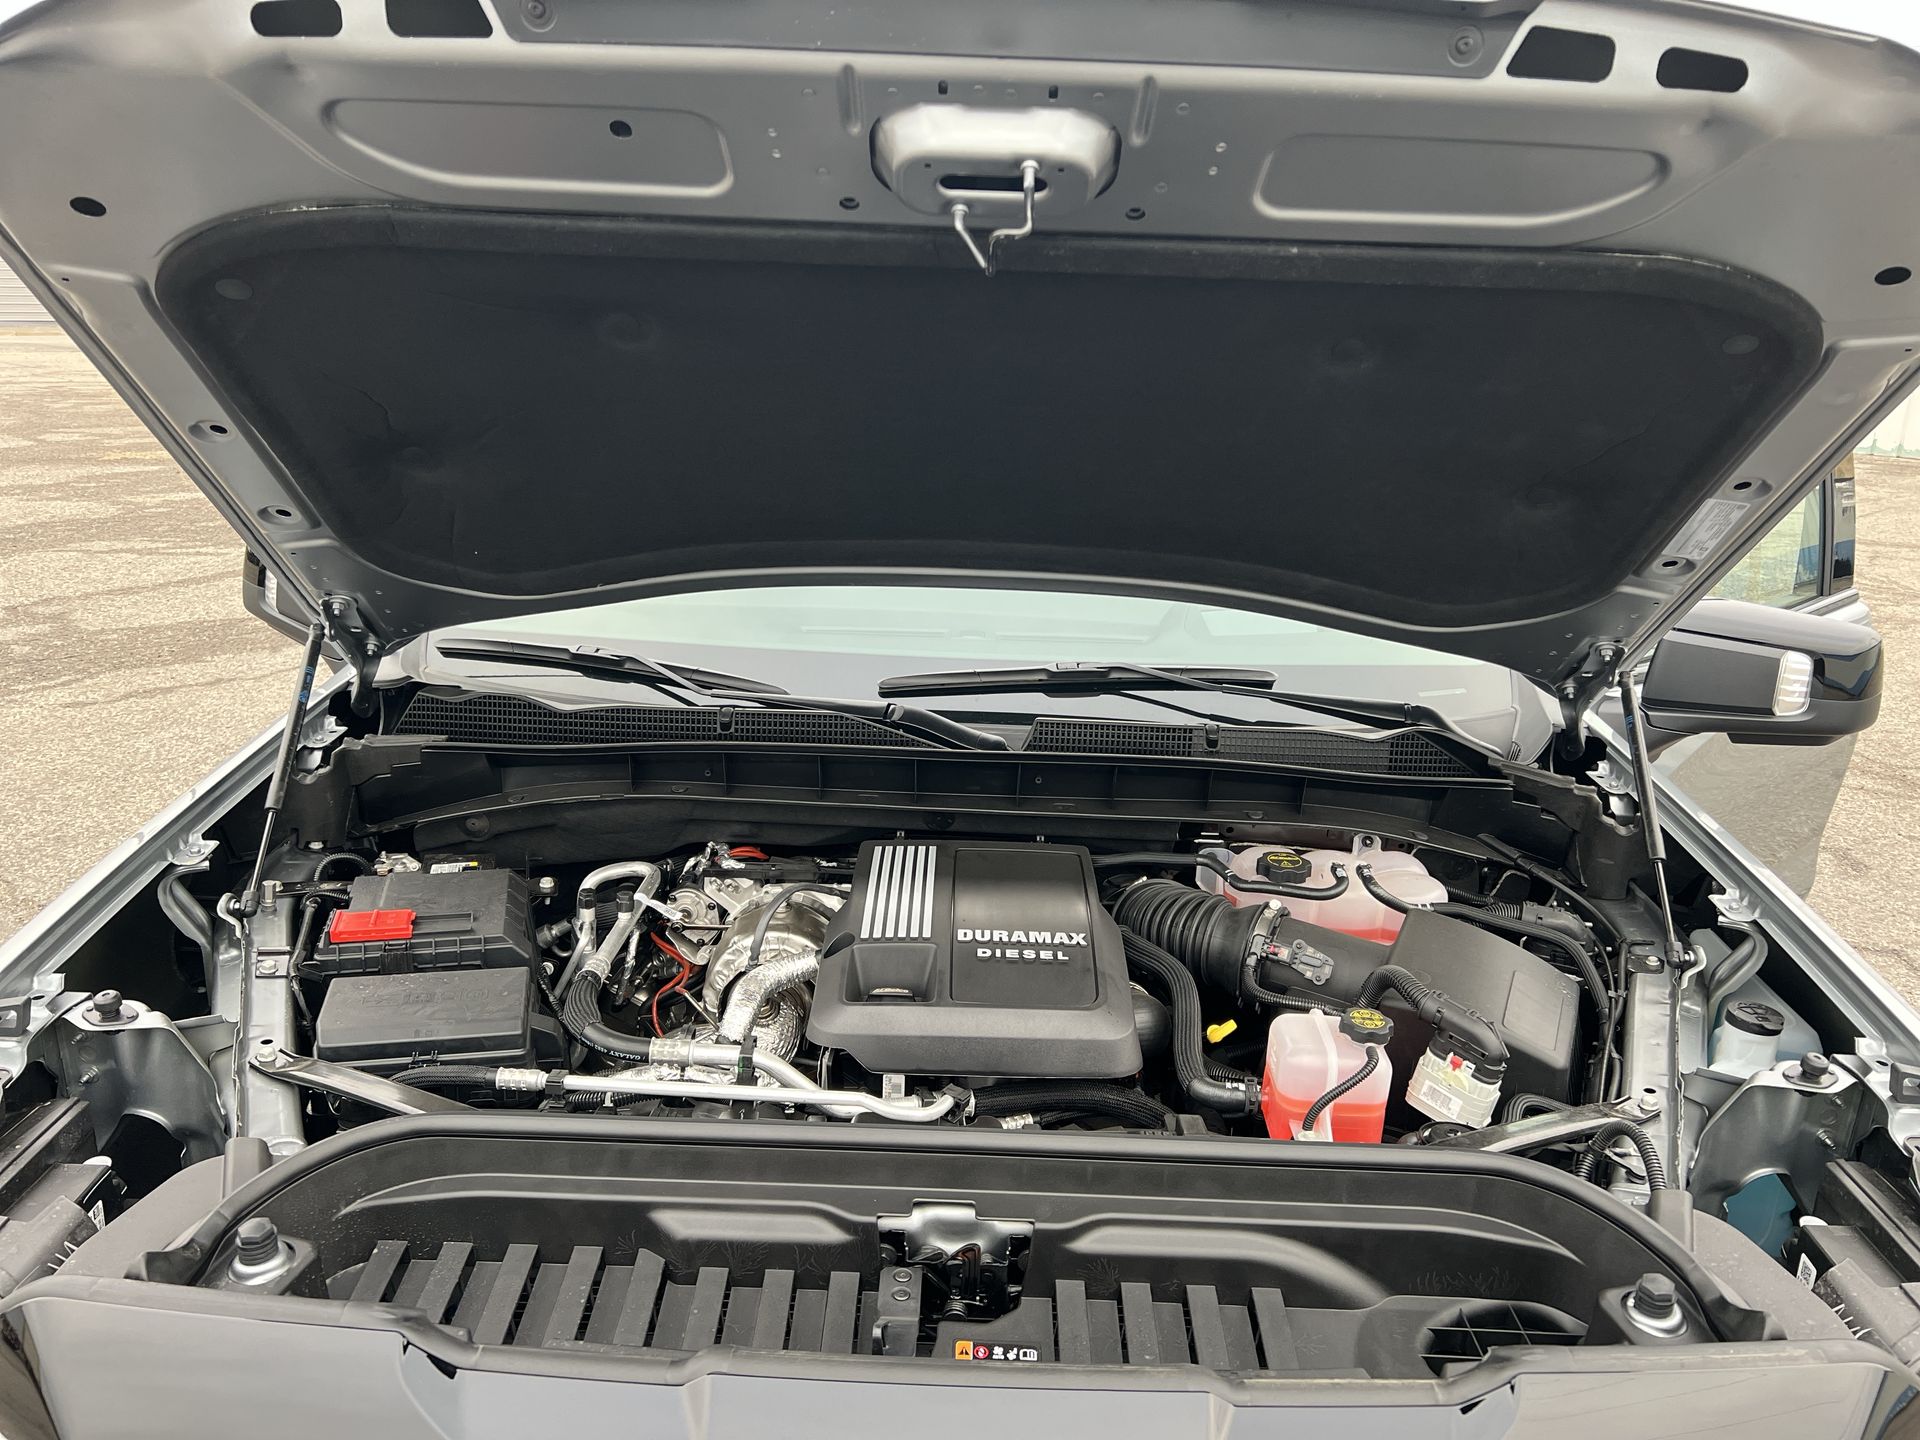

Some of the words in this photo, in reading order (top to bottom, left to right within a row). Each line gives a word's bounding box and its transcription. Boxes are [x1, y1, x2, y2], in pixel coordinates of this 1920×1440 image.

[957, 928, 1087, 946] DURAMAX
[976, 948, 1070, 960] DIESEL
[608, 1050, 641, 1060] GALAXY
